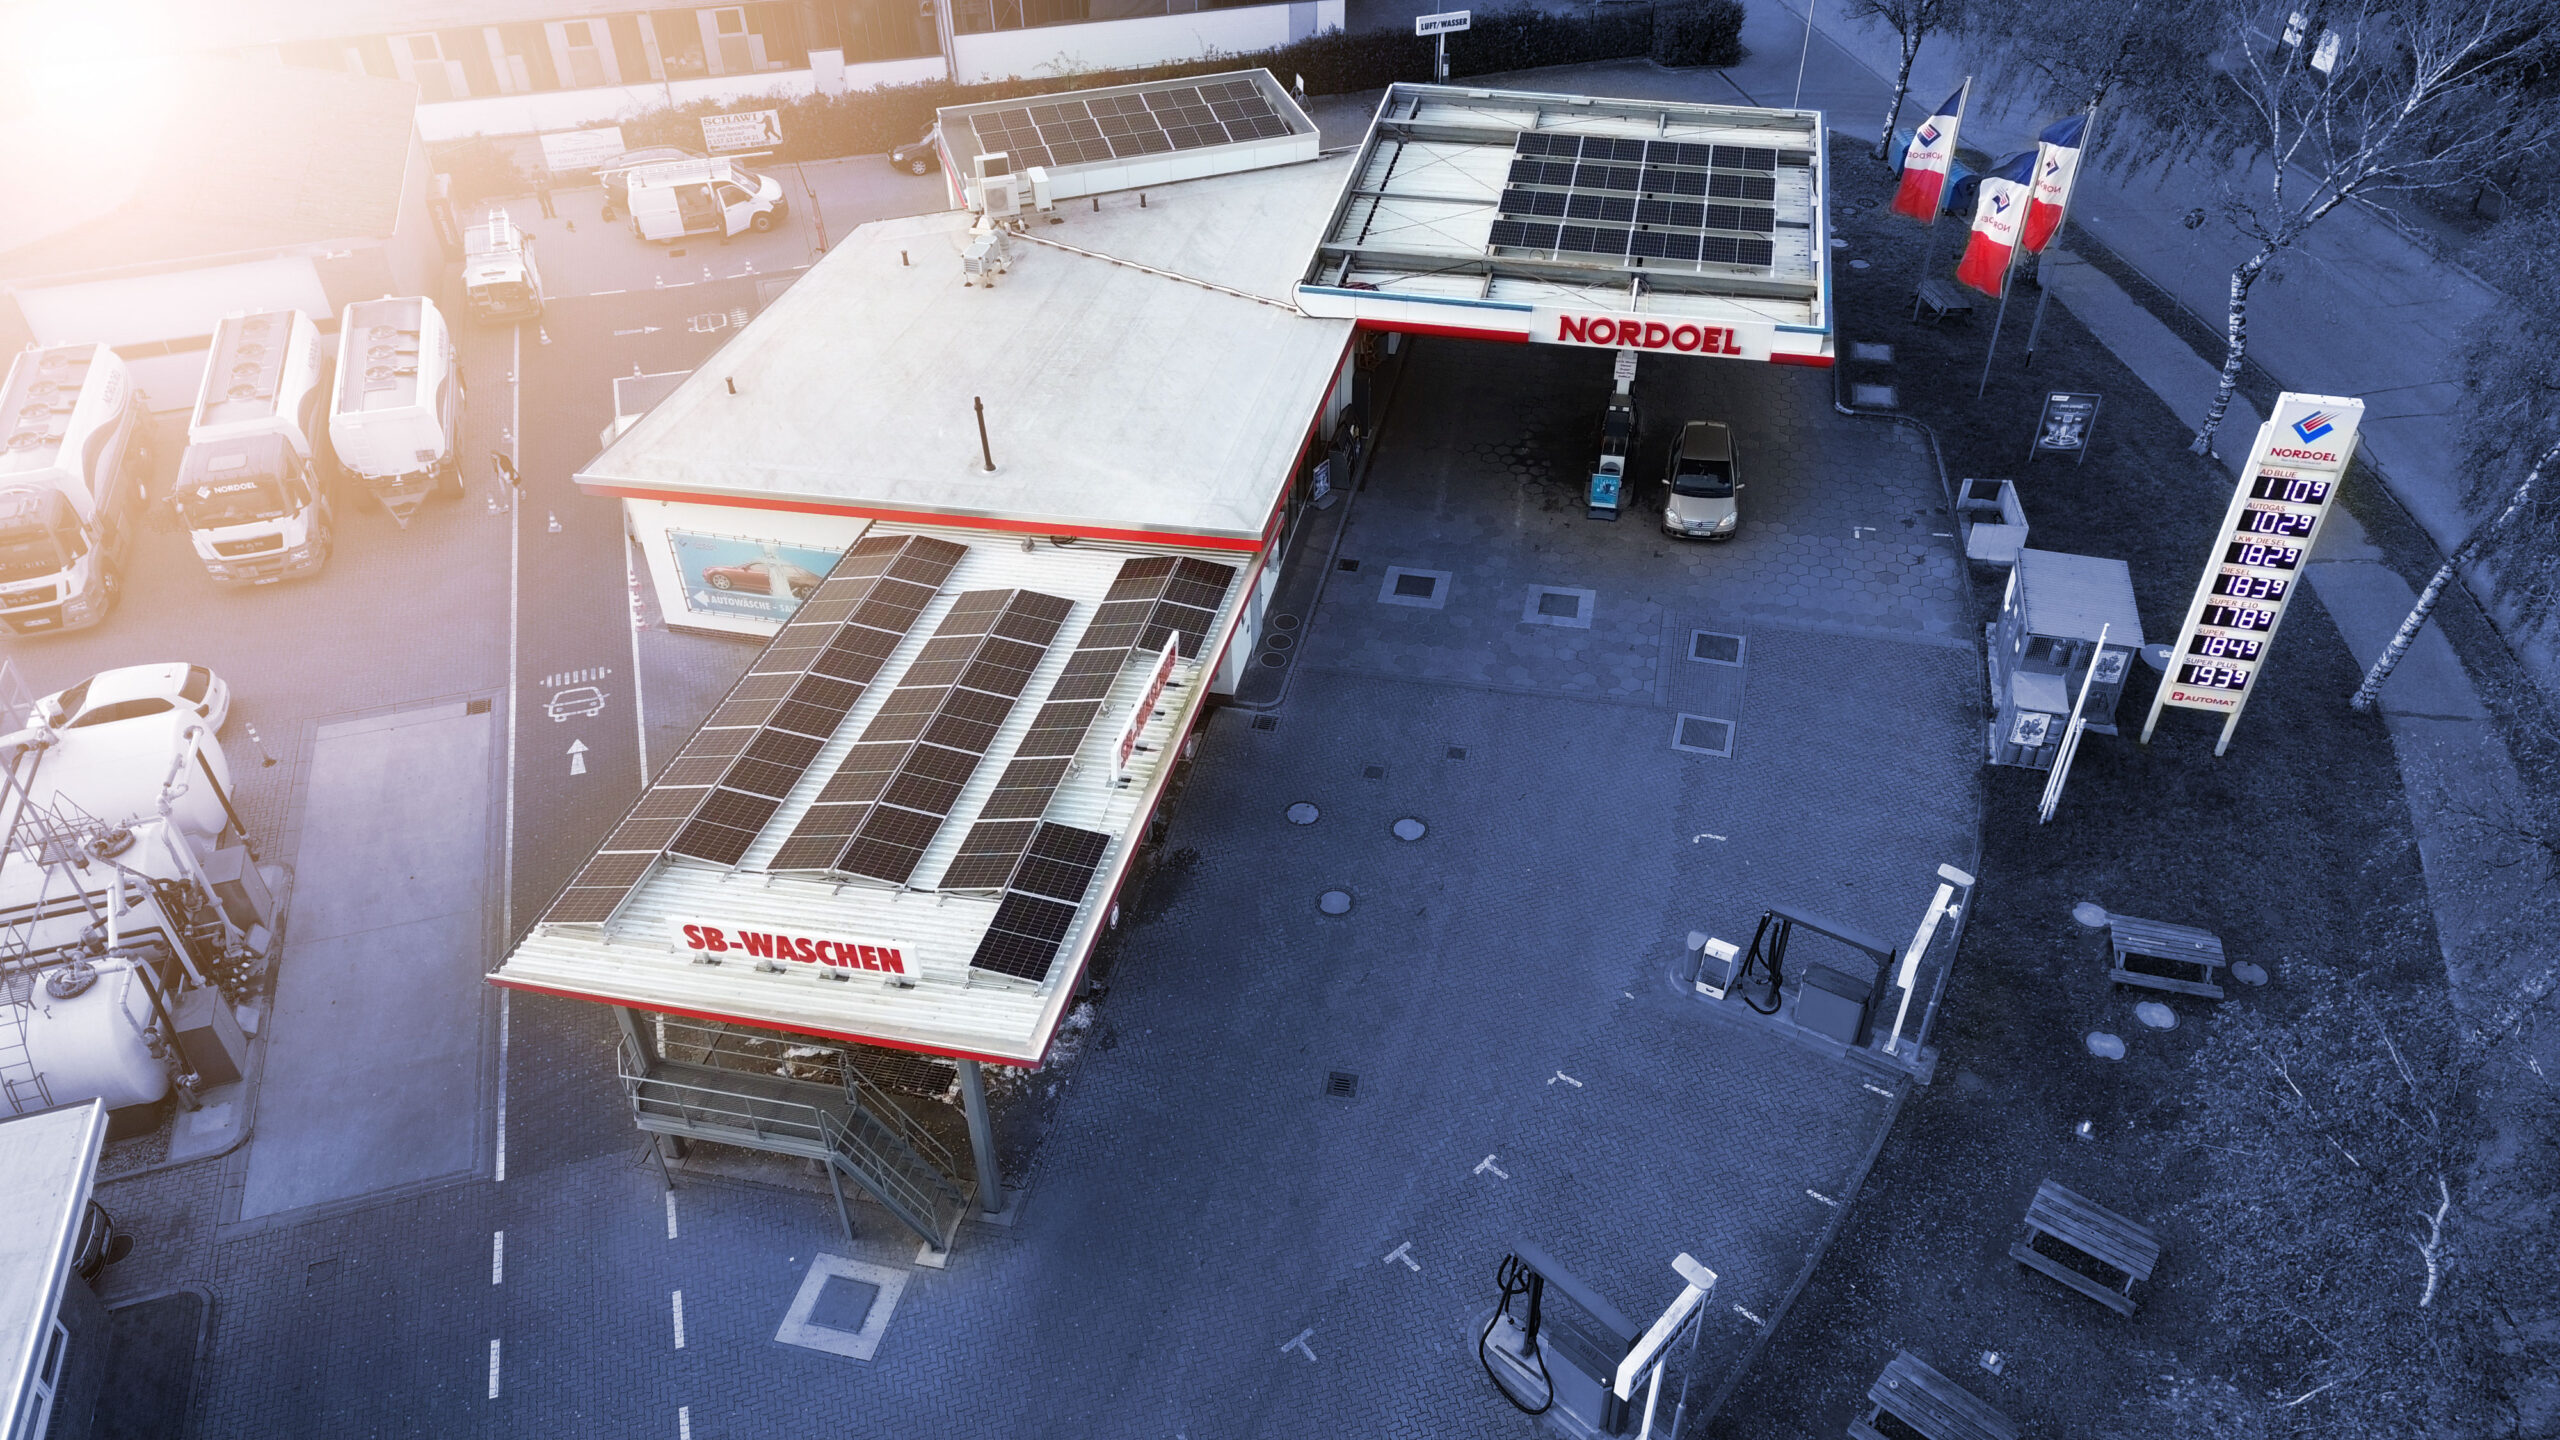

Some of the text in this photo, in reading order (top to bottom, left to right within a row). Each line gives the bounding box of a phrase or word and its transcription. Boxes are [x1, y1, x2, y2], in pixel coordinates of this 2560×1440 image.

[1421, 18, 1468, 31] LUFT/WASSER
[703, 113, 757, 126] SCHAWI
[1558, 315, 1741, 355] NORDOEL
[2270, 447, 2337, 462] NORDOEL
[2274, 469, 2298, 478] BLUE
[214, 482, 258, 494] NORDOEL
[2246, 502, 2287, 512] AUTOGAS
[2233, 534, 2287, 546] LKW DIESEL
[2221, 566, 2251, 575] DIESEL
[711, 595, 771, 611] AUTOWÄSCHE
[2208, 597, 2258, 609] SUPER E10
[2198, 628, 2225, 637] SUPER
[2185, 657, 2238, 669] SUPER PLUS
[2184, 695, 2236, 706] AUTOMAT
[683, 924, 905, 974] SB-WASCHEN
